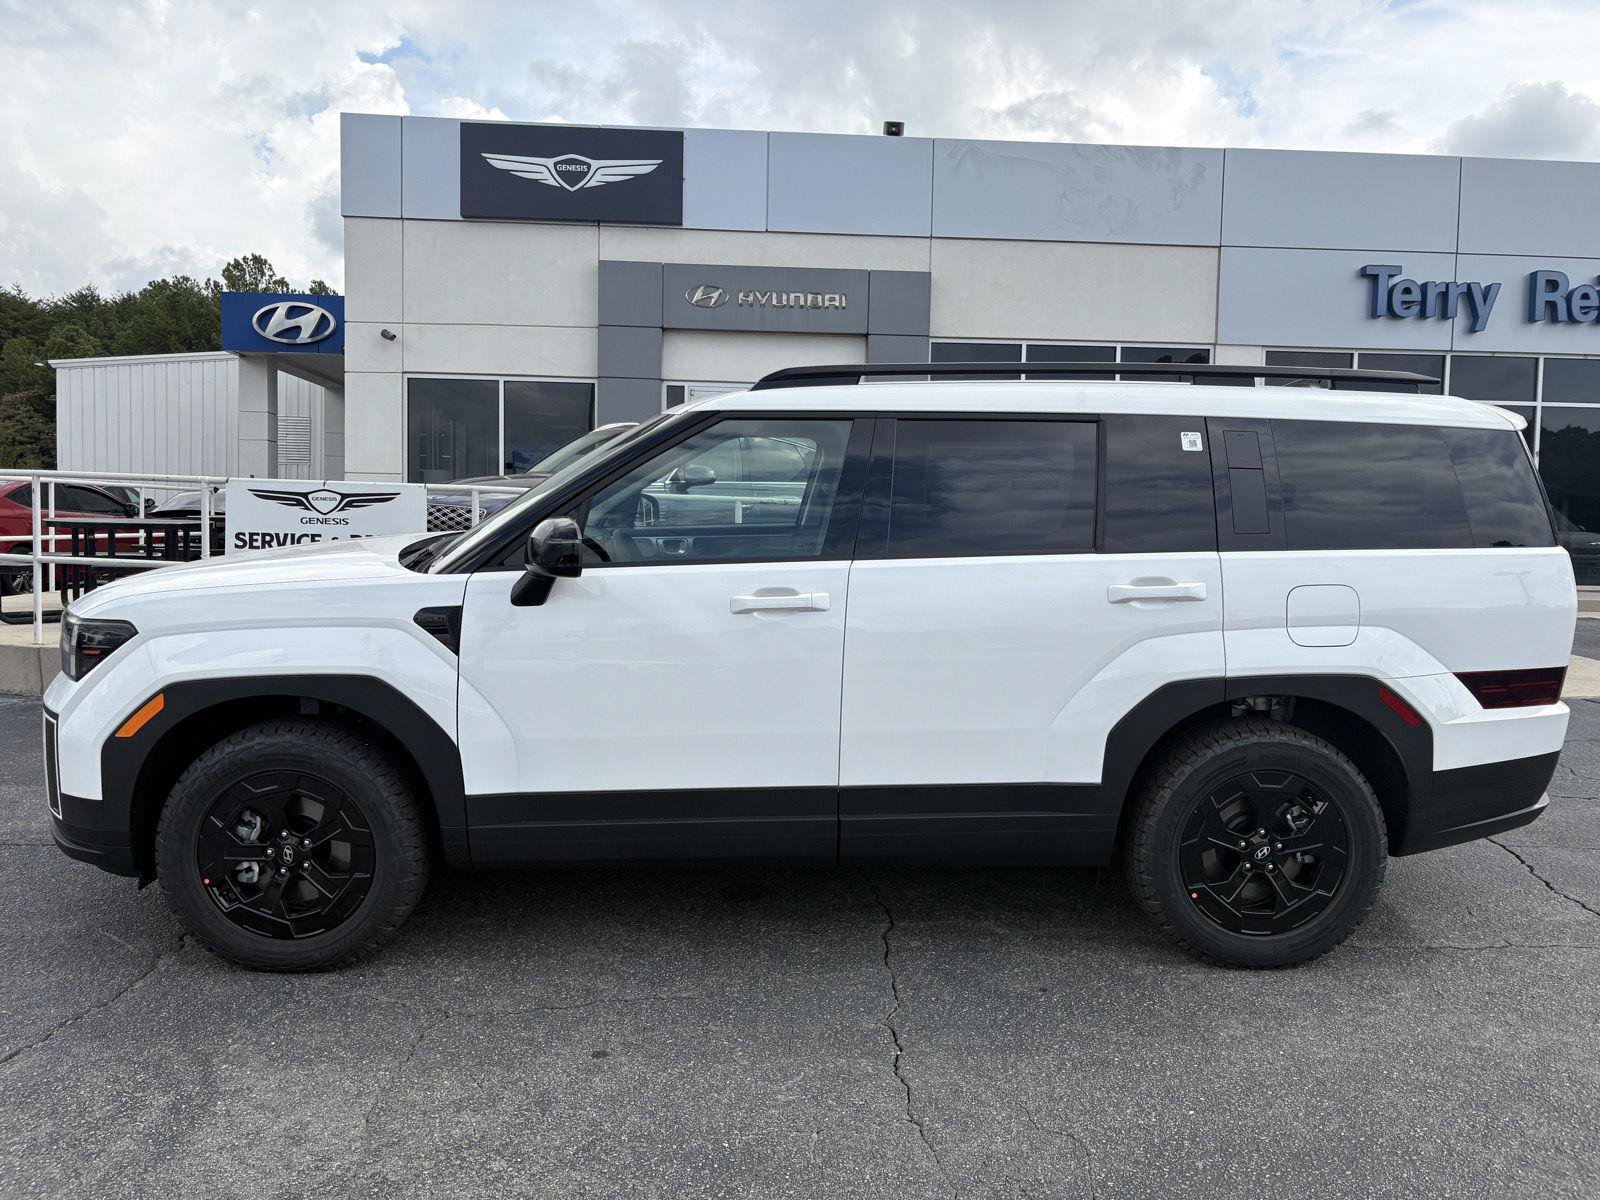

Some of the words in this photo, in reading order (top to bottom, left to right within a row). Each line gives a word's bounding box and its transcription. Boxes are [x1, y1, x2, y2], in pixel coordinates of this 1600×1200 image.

[556, 164, 588, 172] GENESIS
[738, 290, 847, 310] HYUNDAI
[1361, 264, 1502, 333] Terry
[1528, 269, 1600, 323] Re
[300, 517, 349, 526] GENESIS
